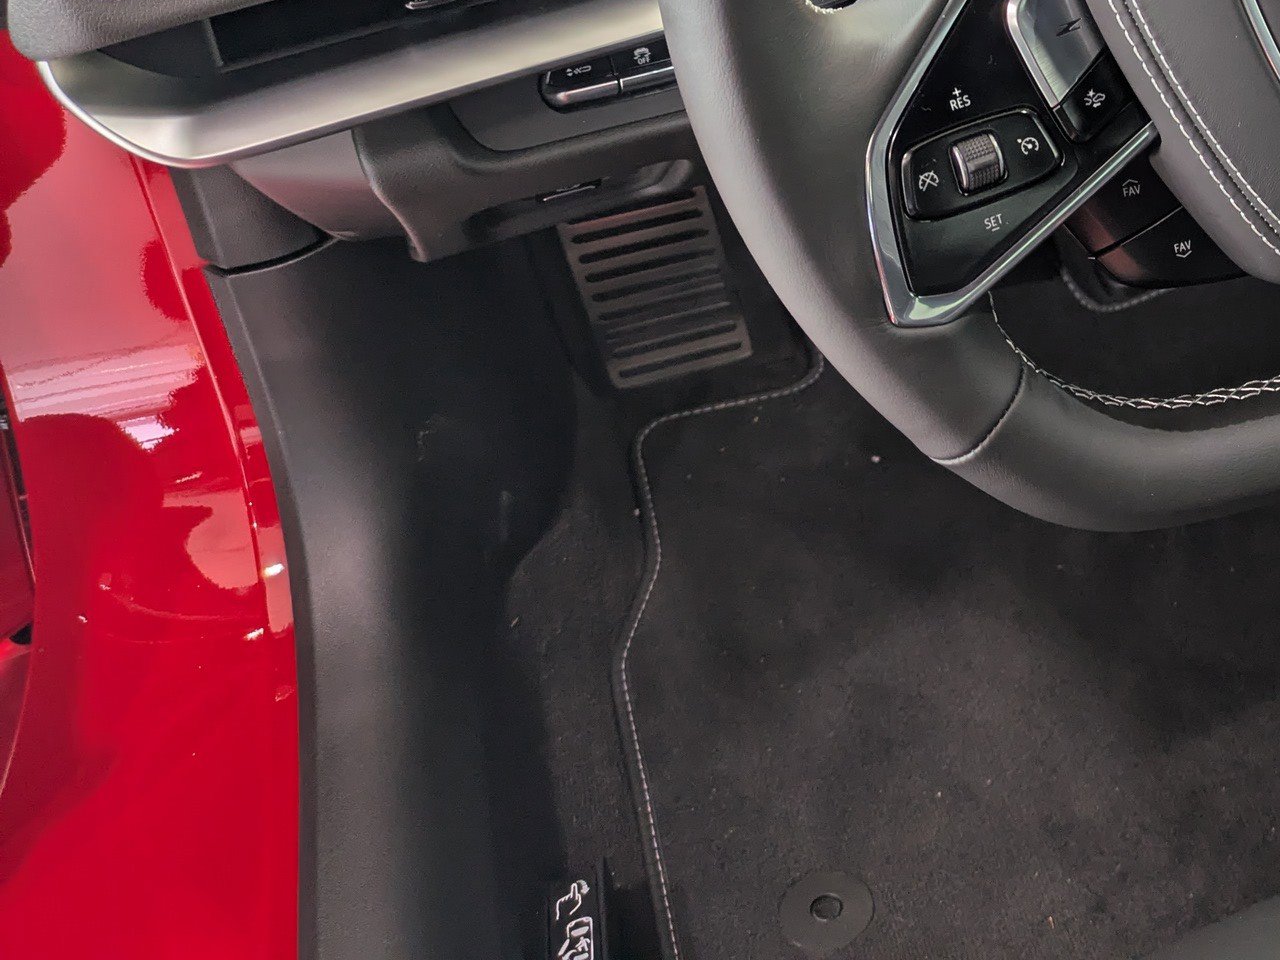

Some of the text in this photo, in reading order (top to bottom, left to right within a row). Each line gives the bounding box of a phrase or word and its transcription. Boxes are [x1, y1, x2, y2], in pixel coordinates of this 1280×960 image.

[637, 57, 651, 65] OFF
[949, 95, 972, 112] RES
[1122, 185, 1142, 198] FAV
[983, 213, 1003, 229] SET
[1173, 239, 1192, 253] FAV
